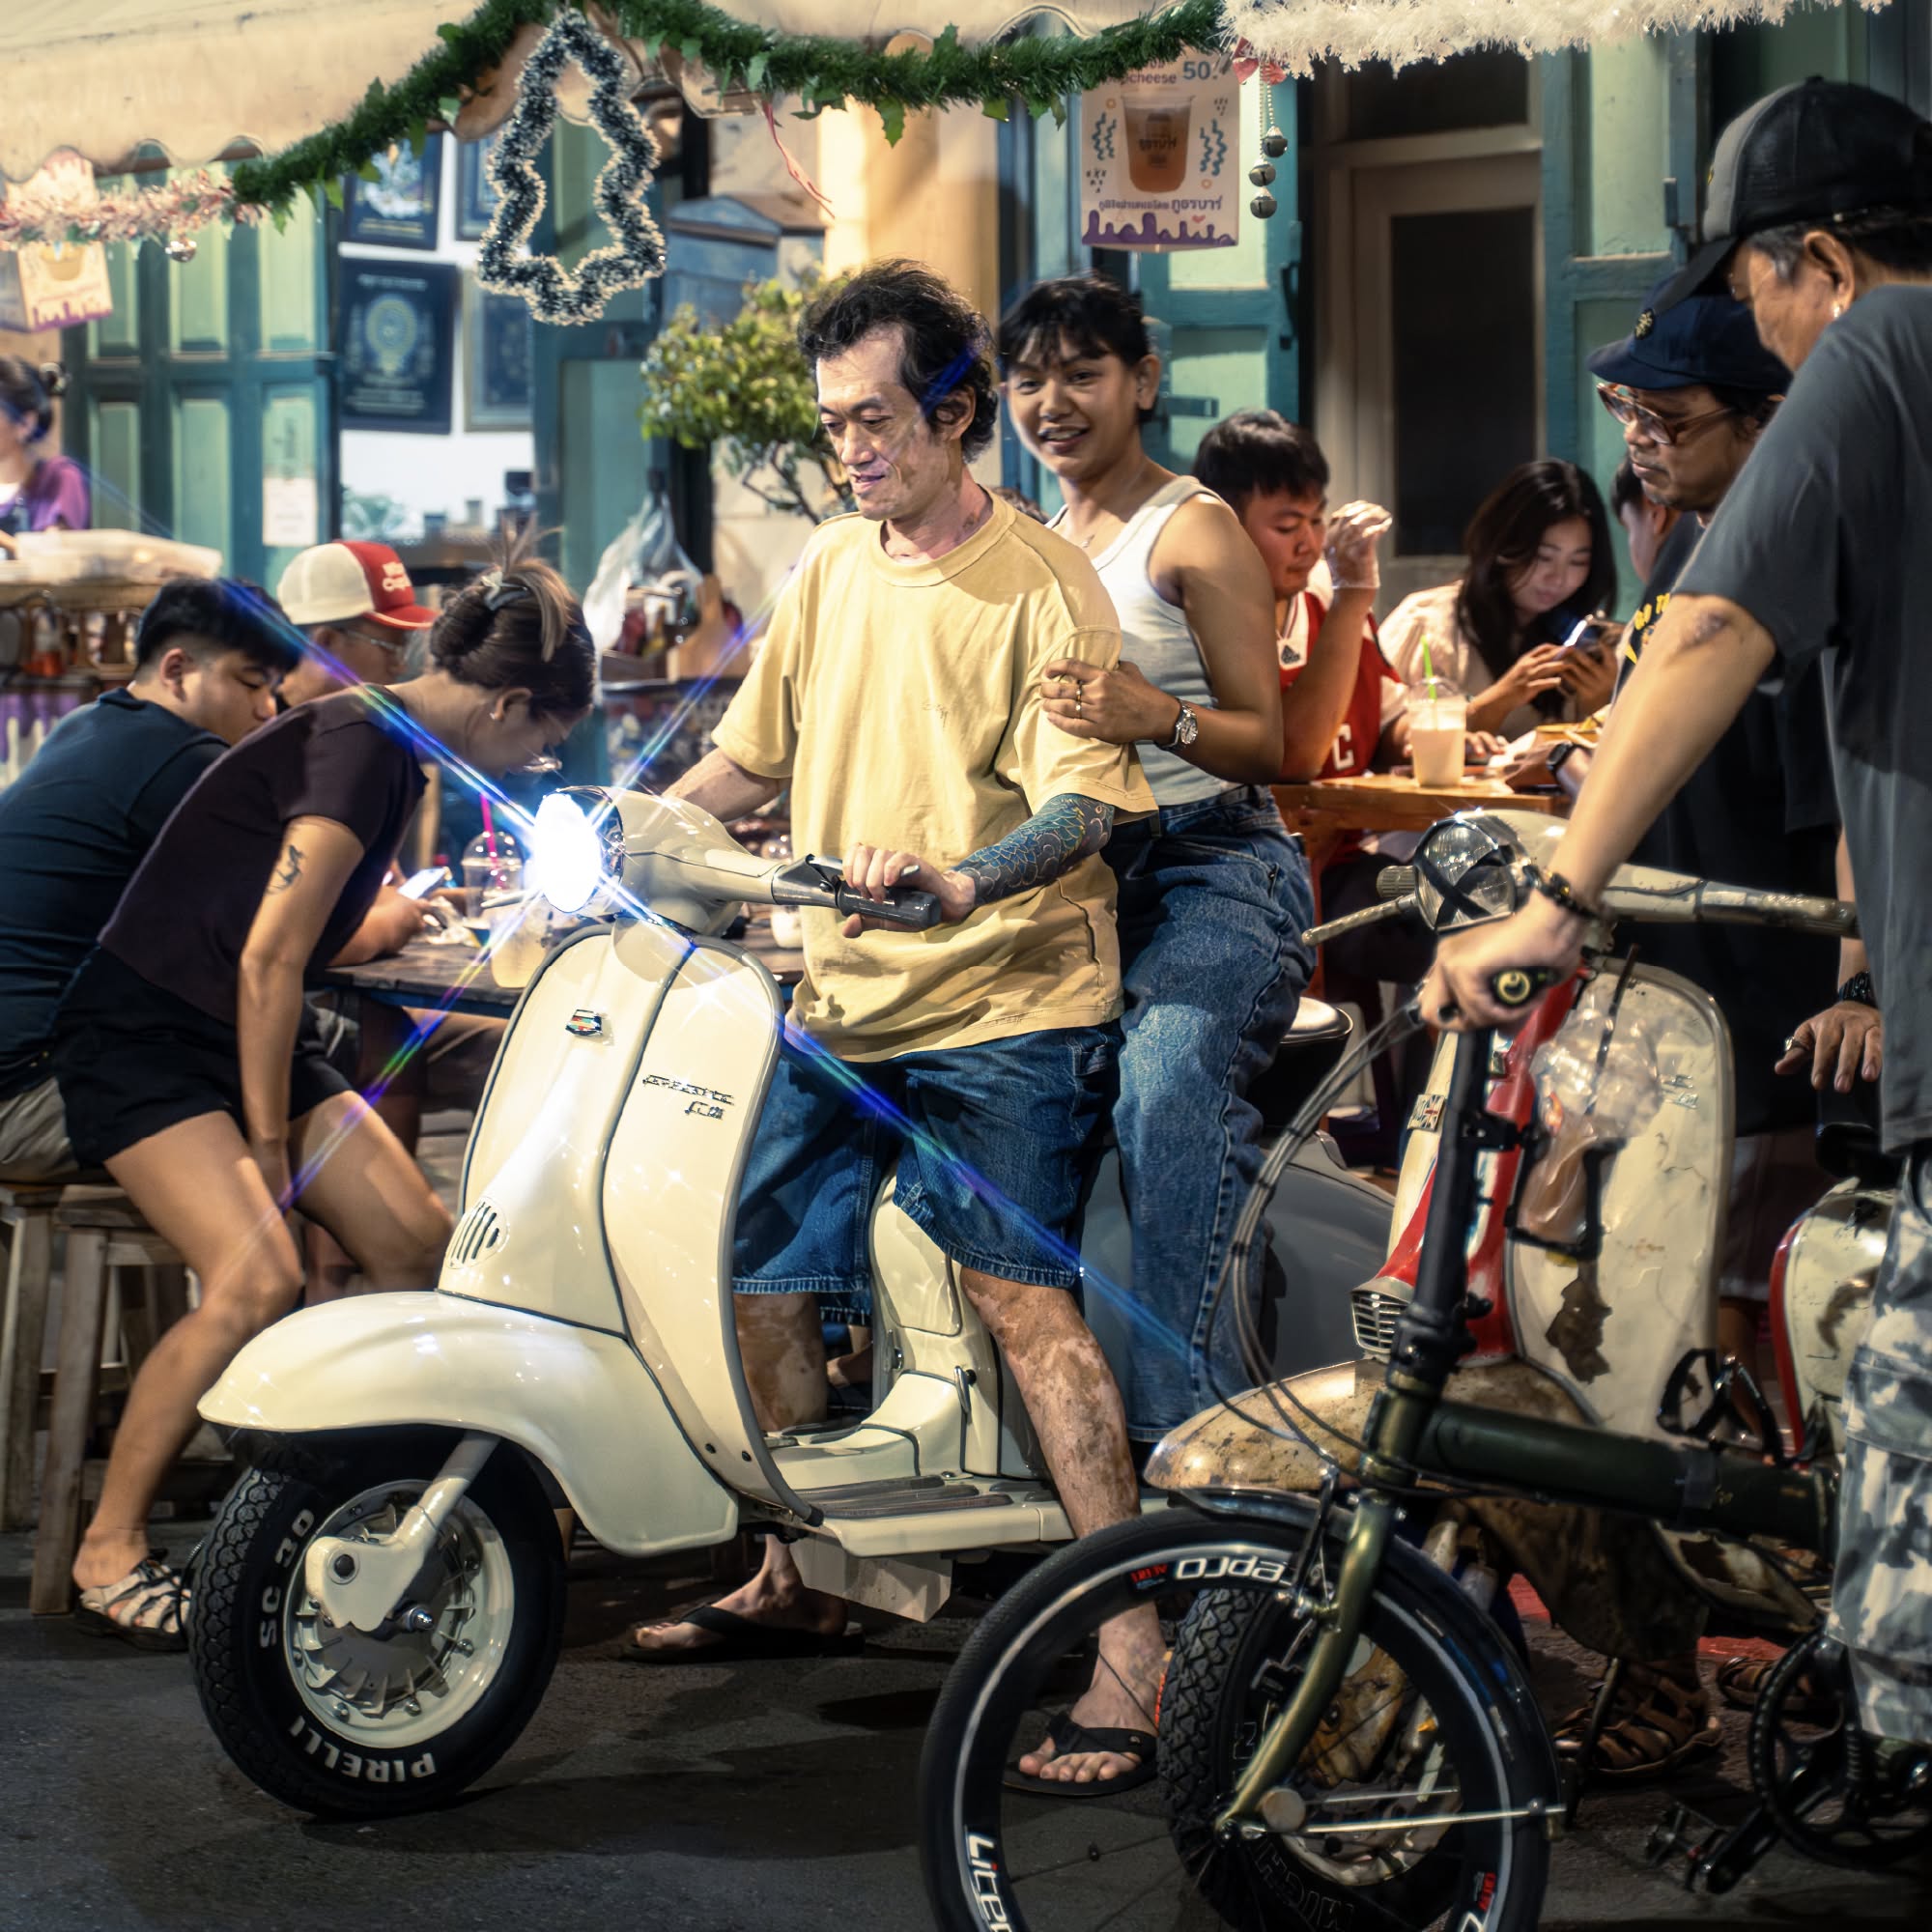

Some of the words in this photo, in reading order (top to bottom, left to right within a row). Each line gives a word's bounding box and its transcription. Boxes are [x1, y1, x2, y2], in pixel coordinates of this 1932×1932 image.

[1101, 72, 1178, 85] cheese
[1176, 1555, 1293, 1587] epro
[290, 1715, 437, 1783] PIRELLI
